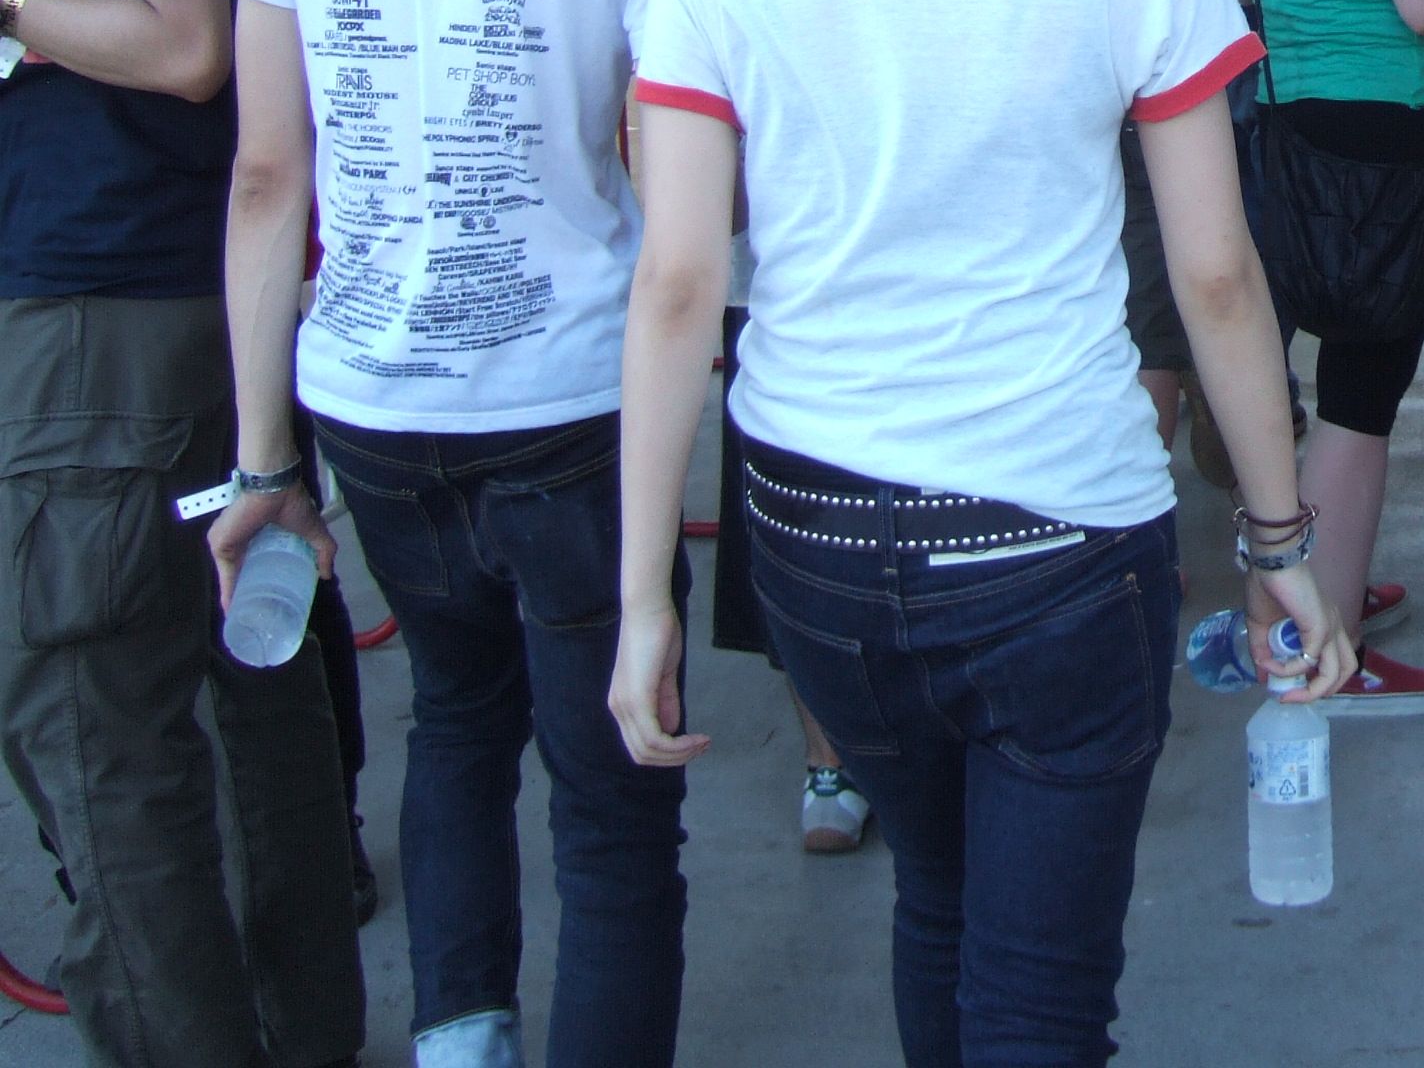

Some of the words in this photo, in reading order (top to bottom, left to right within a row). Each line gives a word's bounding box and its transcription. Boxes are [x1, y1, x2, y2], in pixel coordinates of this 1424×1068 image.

[447, 67, 471, 81] PET
[472, 68, 508, 84] SHOP
[471, 83, 487, 93] THE
[356, 91, 399, 100] MOUSE
[462, 173, 478, 182] CUT
